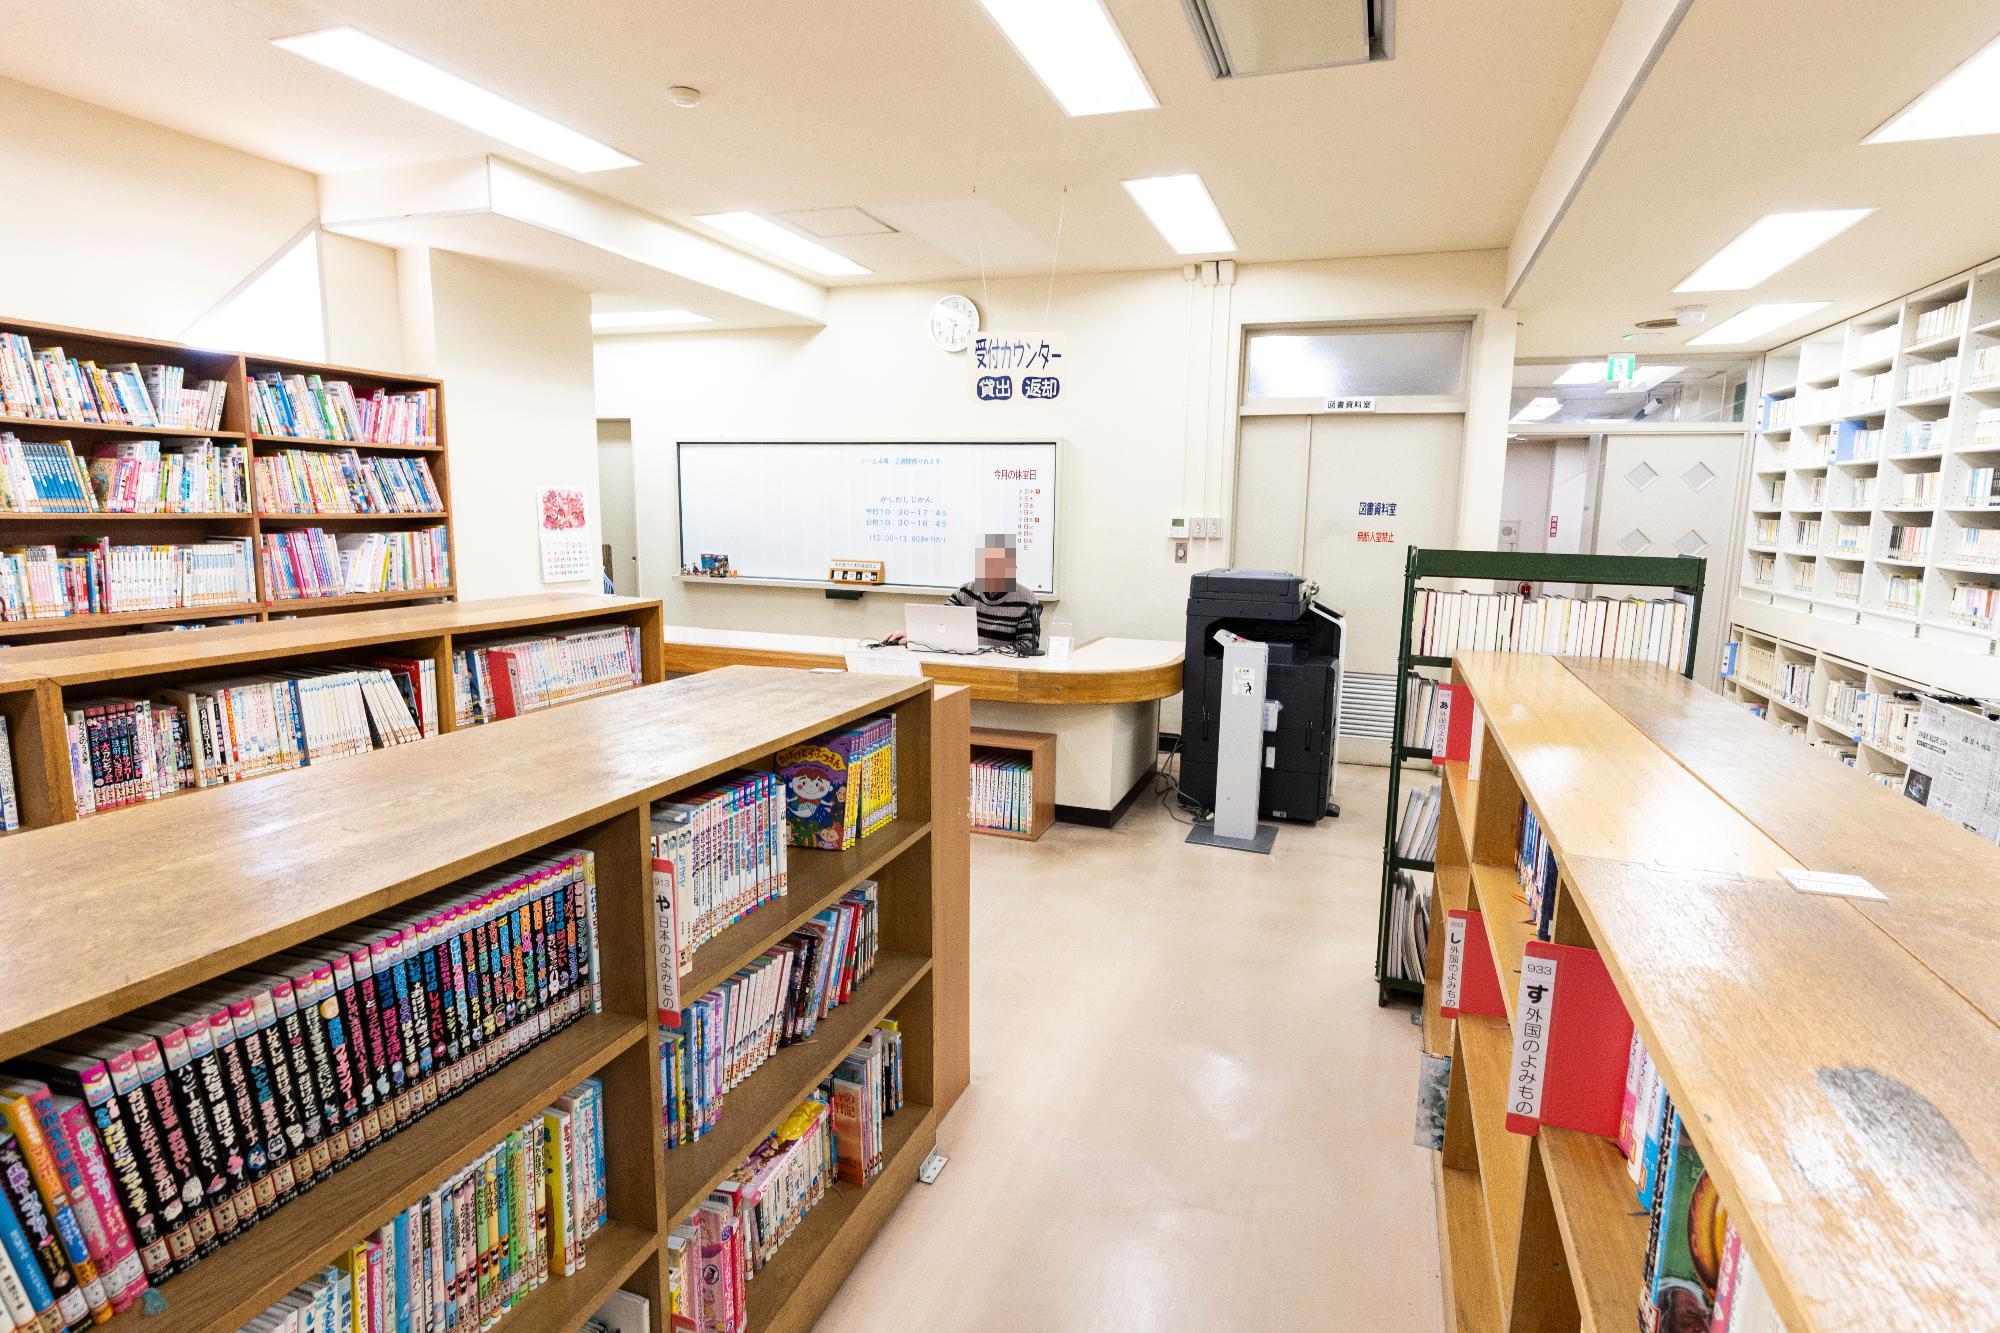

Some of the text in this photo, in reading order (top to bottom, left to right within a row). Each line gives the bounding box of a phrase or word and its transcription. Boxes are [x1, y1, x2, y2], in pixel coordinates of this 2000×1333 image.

[975, 337, 1061, 369] 受付カウンター
[979, 378, 1057, 398] 貸出 返却
[1327, 400, 1371, 409] 図書資料室
[993, 469, 1037, 481] 今月の休室日
[1358, 501, 1398, 517] 図書資料室
[1439, 701, 1449, 710] あ
[654, 877, 670, 888] 913
[655, 894, 671, 911] や
[1450, 932, 1463, 945] し
[658, 916, 675, 1009] 日本のよみもの
[1526, 962, 1553, 976] 933
[1445, 946, 1461, 1008] 外国のよみもの
[1526, 984, 1548, 1004] す
[1515, 1007, 1545, 1116] 外国のよみもの
